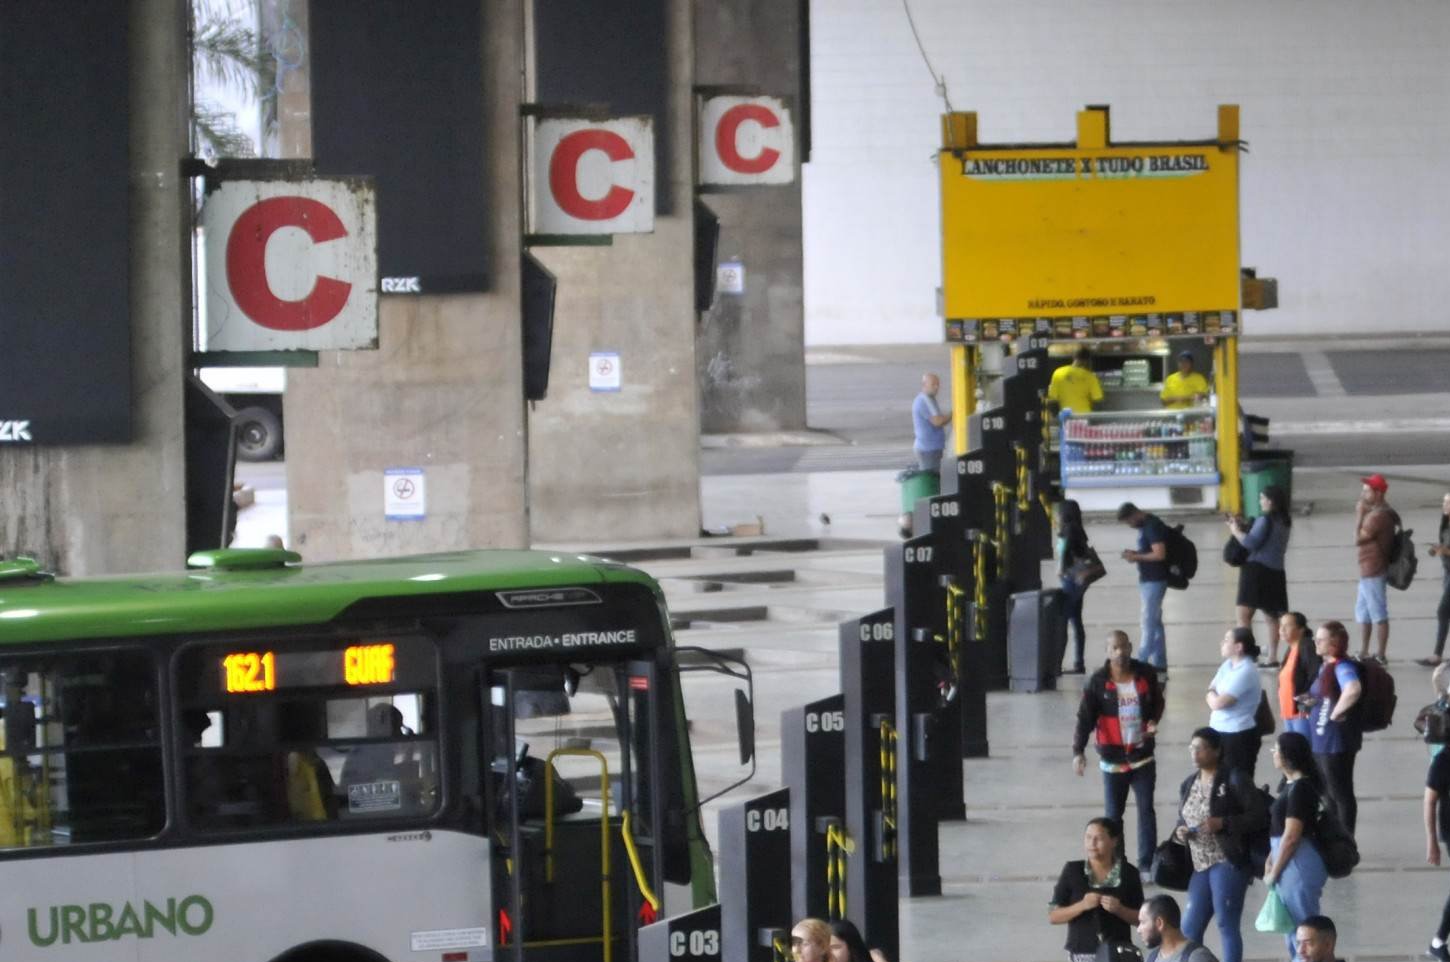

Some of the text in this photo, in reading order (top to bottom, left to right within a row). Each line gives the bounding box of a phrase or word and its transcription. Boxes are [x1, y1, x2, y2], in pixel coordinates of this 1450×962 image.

[715, 104, 780, 174] C
[549, 129, 635, 221] C
[961, 155, 1209, 176] LANCHONETE X TUDO BRASIL
[226, 196, 351, 331] C
[381, 277, 421, 292] RZK
[983, 416, 1004, 430] C 10
[958, 459, 984, 475] C 09
[931, 502, 960, 518] C 08
[905, 547, 933, 563] C 07
[489, 630, 635, 651] ENTRADA ENTRANCE
[860, 622, 893, 641] C 06
[806, 711, 845, 733] C 05
[747, 808, 789, 832] C 04
[27, 894, 214, 947] URBANO
[670, 930, 719, 956] C 03
